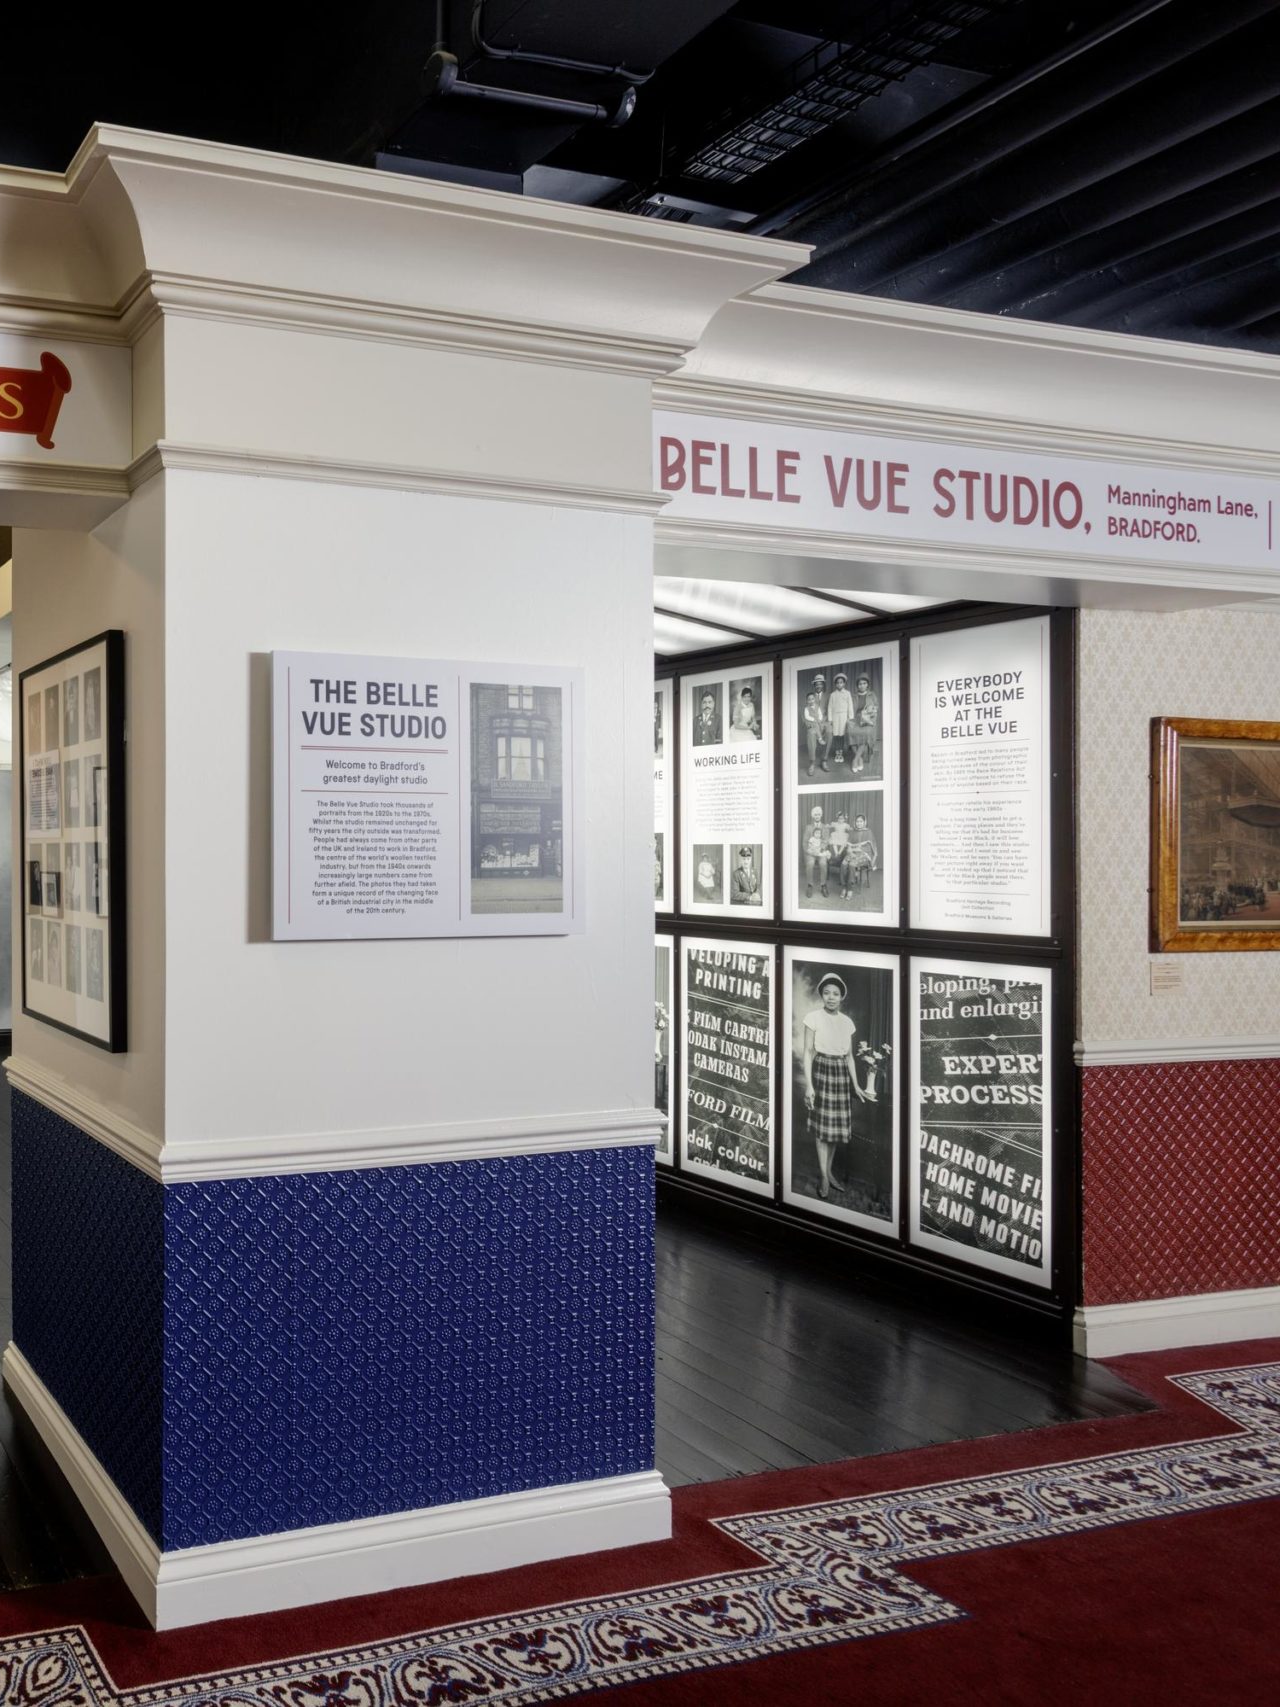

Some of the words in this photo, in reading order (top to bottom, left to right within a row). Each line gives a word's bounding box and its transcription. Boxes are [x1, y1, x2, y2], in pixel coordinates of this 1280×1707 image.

[660, 436, 801, 504] BELLE
[824, 455, 910, 515] VUE
[933, 468, 1091, 535] STUDIO,
[1108, 484, 1211, 515] Manningham
[1217, 495, 1258, 519] Lane,
[1108, 516, 1201, 543] BRADFORD.
[310, 679, 356, 704] THE
[366, 682, 438, 707] BELLE
[937, 671, 1022, 692] EVERYBODY
[935, 697, 946, 708] IS
[952, 688, 1024, 706] WELCOME
[302, 711, 351, 736] VUE
[360, 713, 446, 739] STUDIO
[955, 709, 970, 722] AT
[975, 706, 1002, 720] THE
[941, 724, 982, 738] BELLE
[988, 721, 1017, 734] VUE
[326, 760, 365, 769] Welcome
[369, 762, 377, 770] to
[380, 761, 425, 770] Bradford's
[694, 755, 737, 767] WORKING
[741, 753, 760, 763] LIFE
[323, 775, 361, 784] greatest
[364, 775, 398, 785] daylight
[401, 776, 428, 784] studio
[696, 968, 761, 999] PRINTING
[961, 995, 1042, 1019] enlargi
[694, 1011, 722, 1032] FILM
[688, 1030, 717, 1051] ODAK
[694, 1052, 749, 1083] CAMERAS
[920, 1085, 1042, 1104] PROCESS
[688, 1129, 713, 1151] dak
[718, 1146, 764, 1170] colour
[920, 1130, 1015, 1187] DACHROME
[1020, 1173, 1042, 1200] FI
[926, 1162, 976, 1199] HOME
[922, 1188, 930, 1208] L
[937, 1196, 974, 1227] AND
